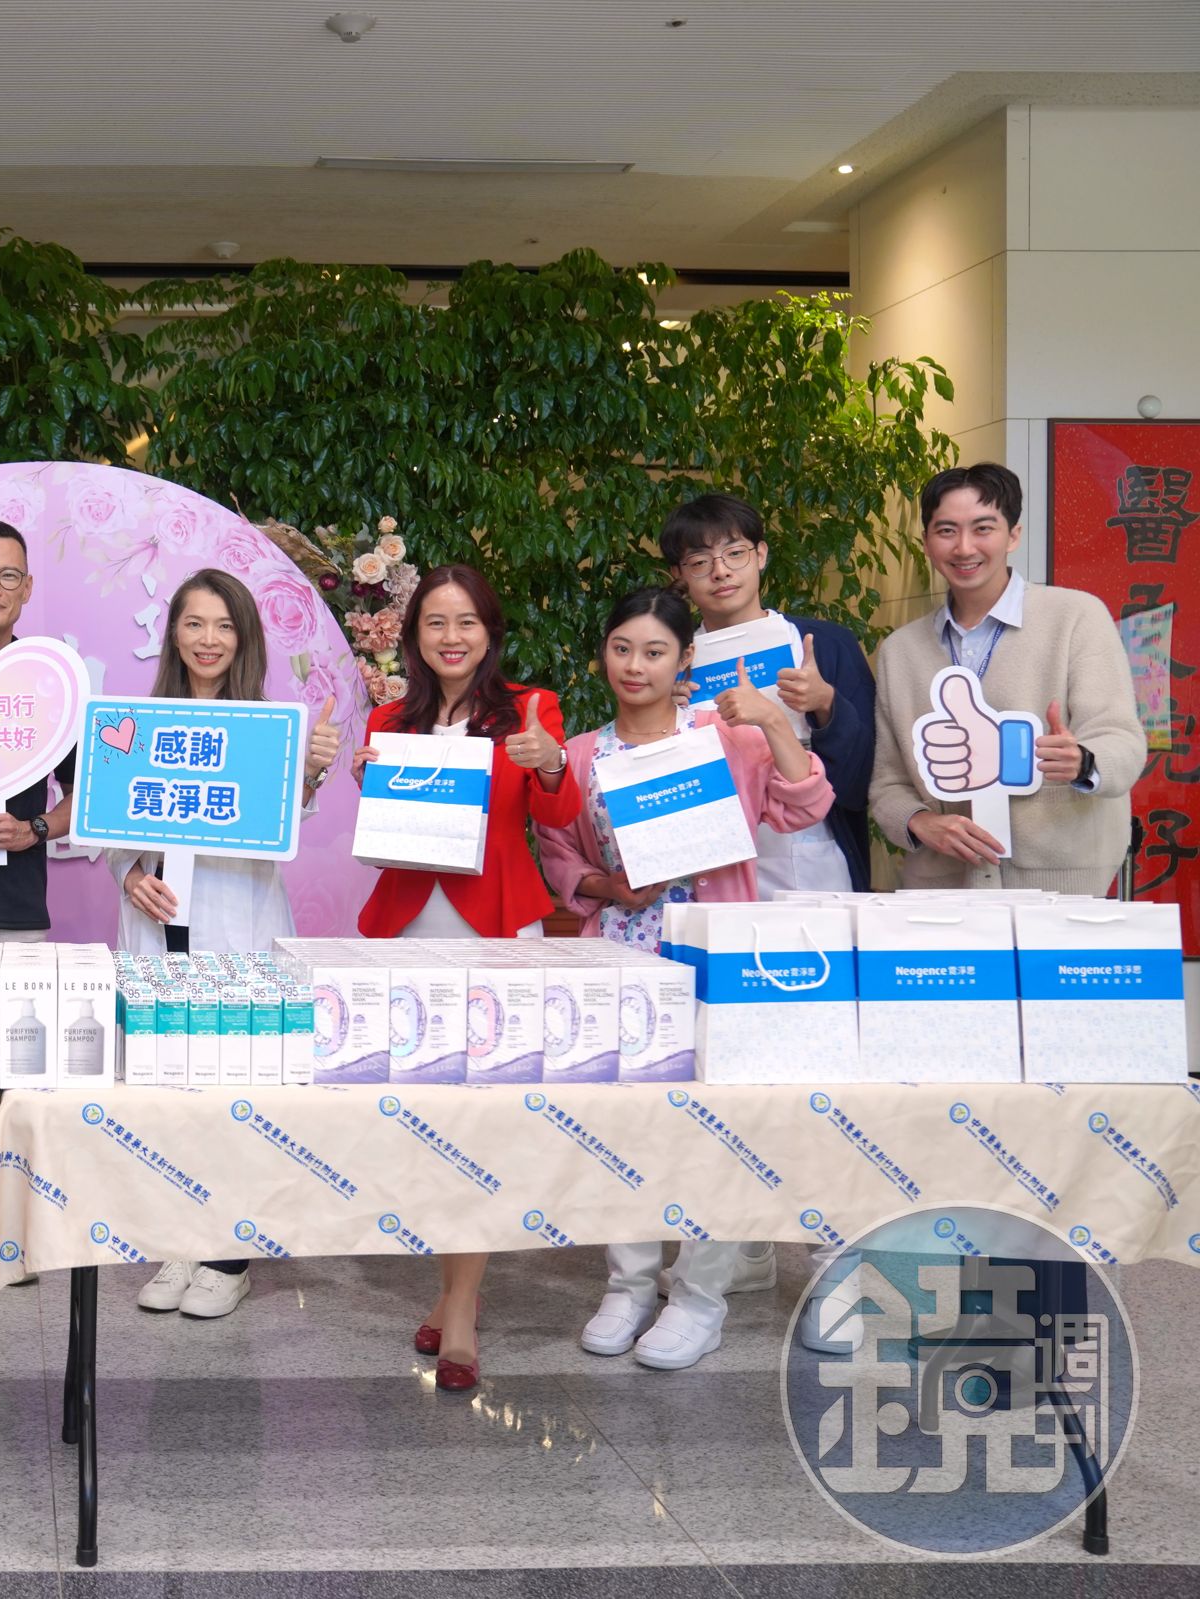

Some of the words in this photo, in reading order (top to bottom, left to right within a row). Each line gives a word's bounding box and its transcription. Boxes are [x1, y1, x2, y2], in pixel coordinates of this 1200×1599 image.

[705, 670, 738, 683] Neogen
[154, 731, 224, 767] 感謝
[635, 785, 678, 803] Neogence
[131, 781, 236, 820] 霓淨思
[741, 968, 789, 980] Neogence
[895, 966, 947, 978] Neogence
[1058, 965, 1112, 977] Neogence
[5, 982, 16, 990] LE
[24, 982, 52, 990] BORN
[83, 983, 110, 991] BORN
[128, 989, 139, 998] 95
[160, 988, 171, 996] 95
[192, 988, 203, 998] 95
[254, 988, 265, 998] 95
[287, 987, 298, 997] 95
